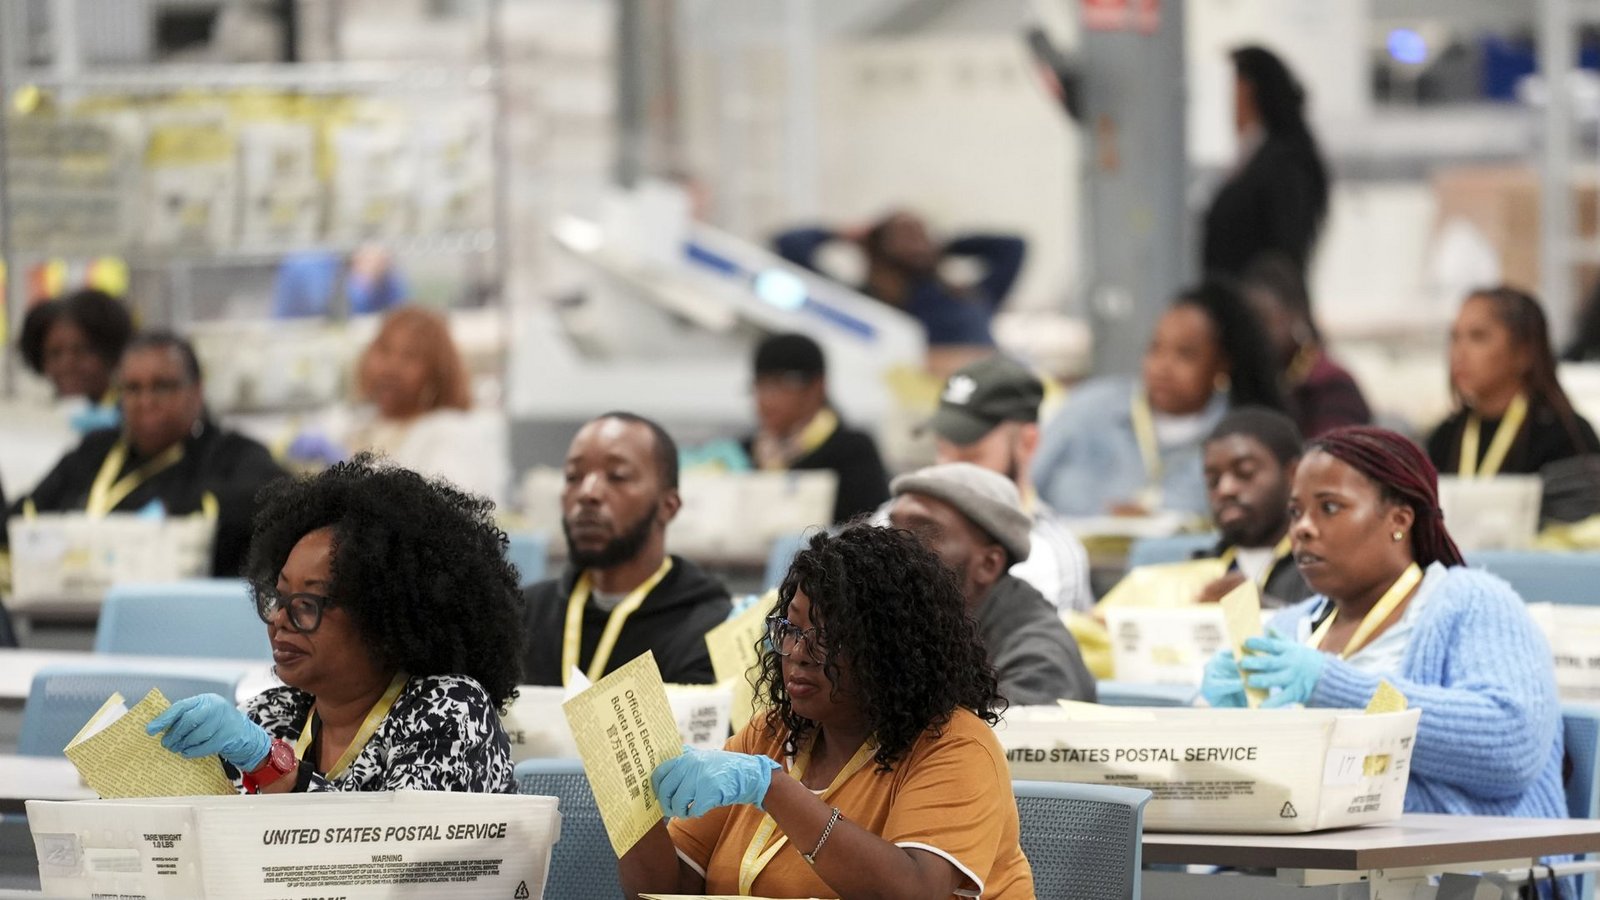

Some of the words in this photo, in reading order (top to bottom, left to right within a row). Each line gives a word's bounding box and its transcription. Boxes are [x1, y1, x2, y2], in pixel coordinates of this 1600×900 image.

[611, 695, 628, 731] Boleta
[625, 732, 647, 779] Electoral
[624, 689, 645, 728] Official
[640, 729, 656, 770] Election
[1006, 748, 1046, 762] ITED
[1049, 748, 1110, 762] STATES
[1114, 748, 1180, 762] POSTAL
[1184, 746, 1258, 762] SERVICE
[143, 833, 158, 841] TARE
[159, 833, 182, 841] WEIGHT
[263, 829, 320, 845] UNITED
[324, 827, 382, 844] STATES
[385, 825, 442, 841] POSTAL
[446, 823, 507, 840] SERVICE
[371, 854, 403, 862] WARNING
